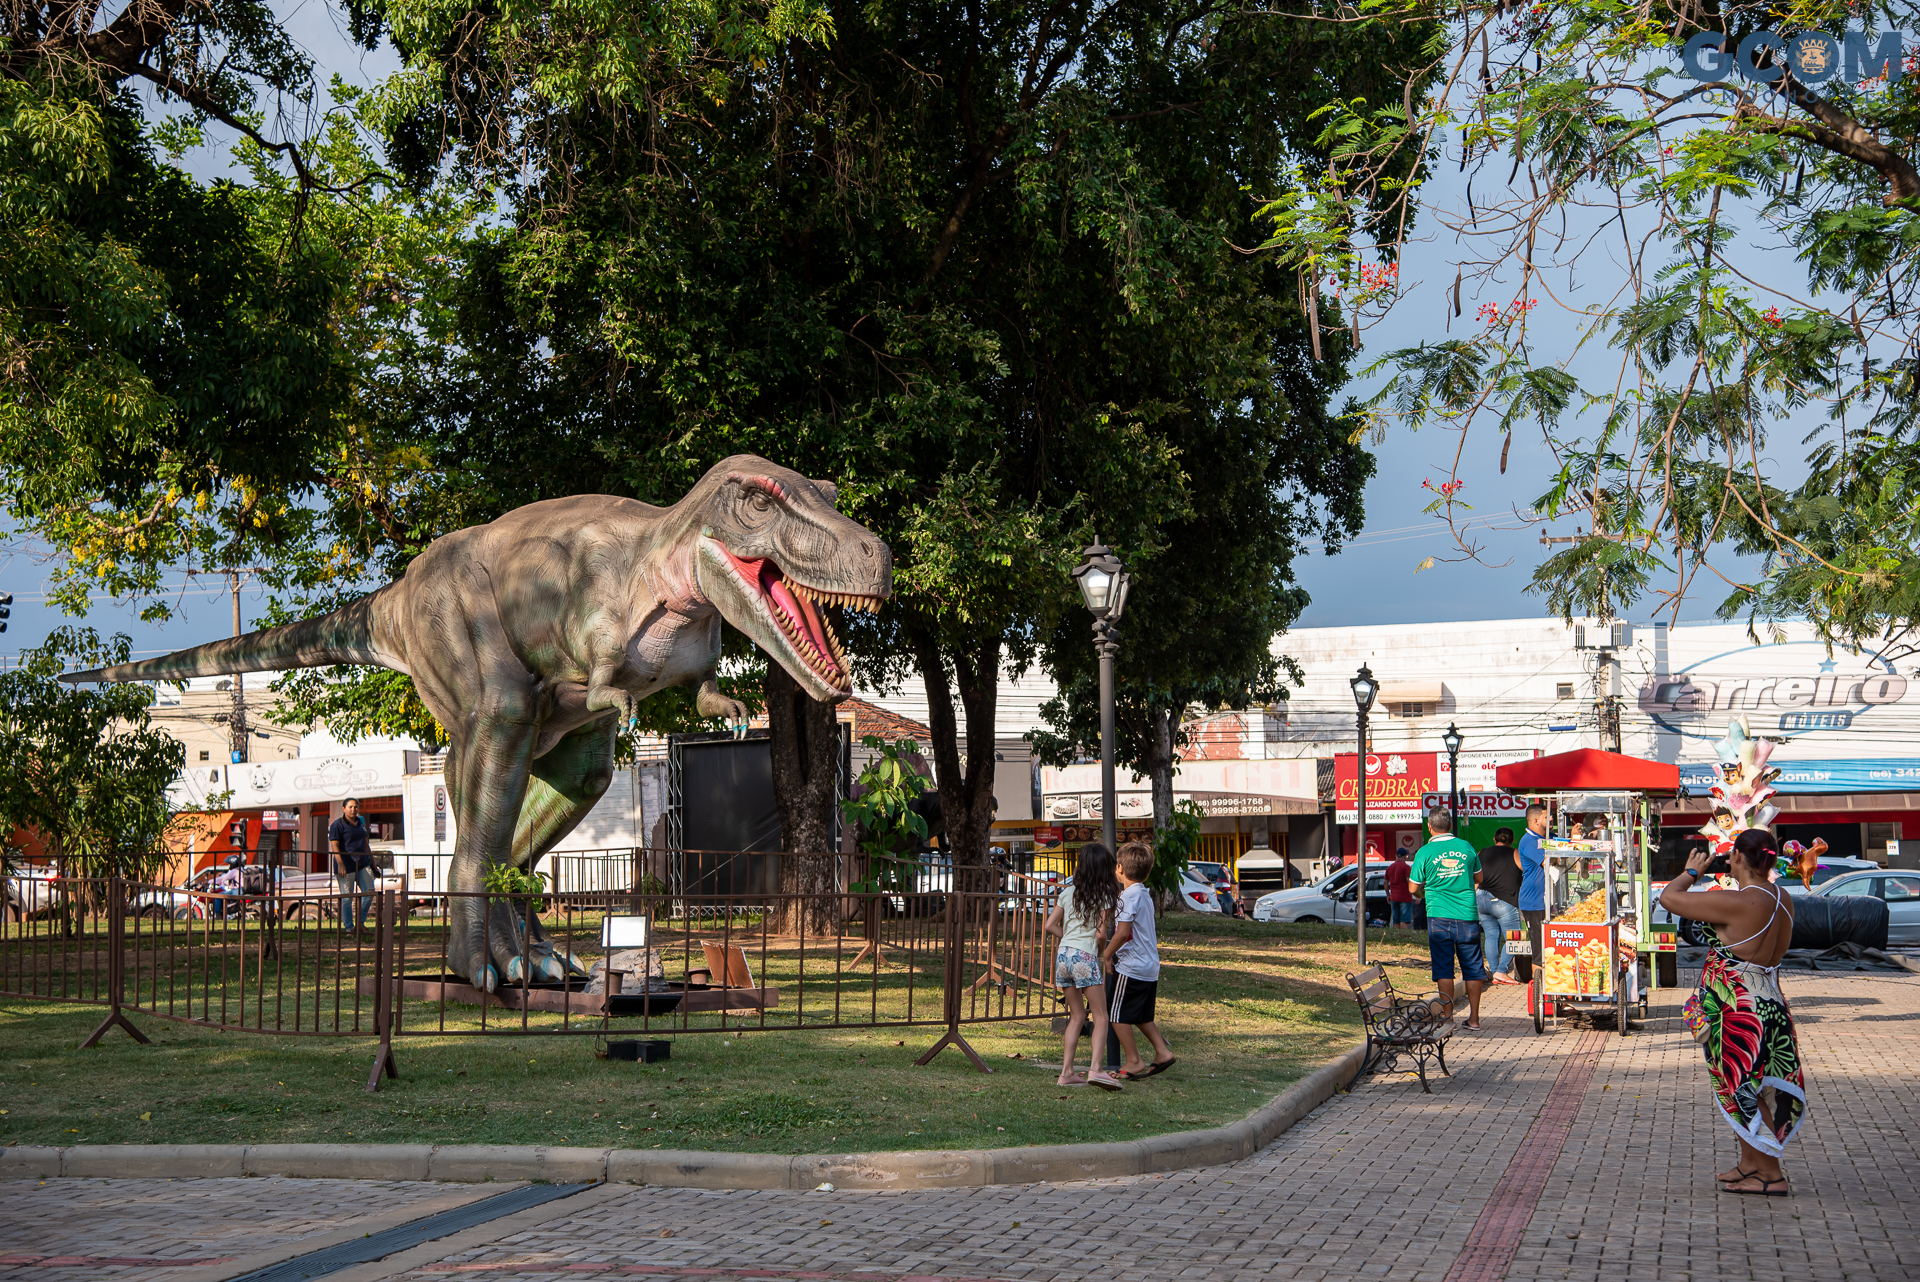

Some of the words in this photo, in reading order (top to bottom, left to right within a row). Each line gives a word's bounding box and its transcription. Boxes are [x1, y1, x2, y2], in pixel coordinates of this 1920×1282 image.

[1638, 674, 1907, 712] Carreiro
[1784, 712, 1846, 729] MÓVEIS
[316, 757, 353, 771] SORVETES
[1482, 760, 1497, 770] olé
[1219, 761, 1300, 791] Gil
[1869, 770, 1892, 779] (66)
[1340, 778, 1431, 797] CREDBRAS
[438, 793, 443, 806] E
[1211, 798, 1264, 806] 99996-1768
[1392, 800, 1418, 808] SONHOS
[1211, 806, 1264, 814] 99996-8760
[1432, 852, 1448, 865] MAC
[1449, 850, 1468, 860] DOG
[1550, 929, 1584, 939] Batata
[1555, 938, 1579, 948] Frita
